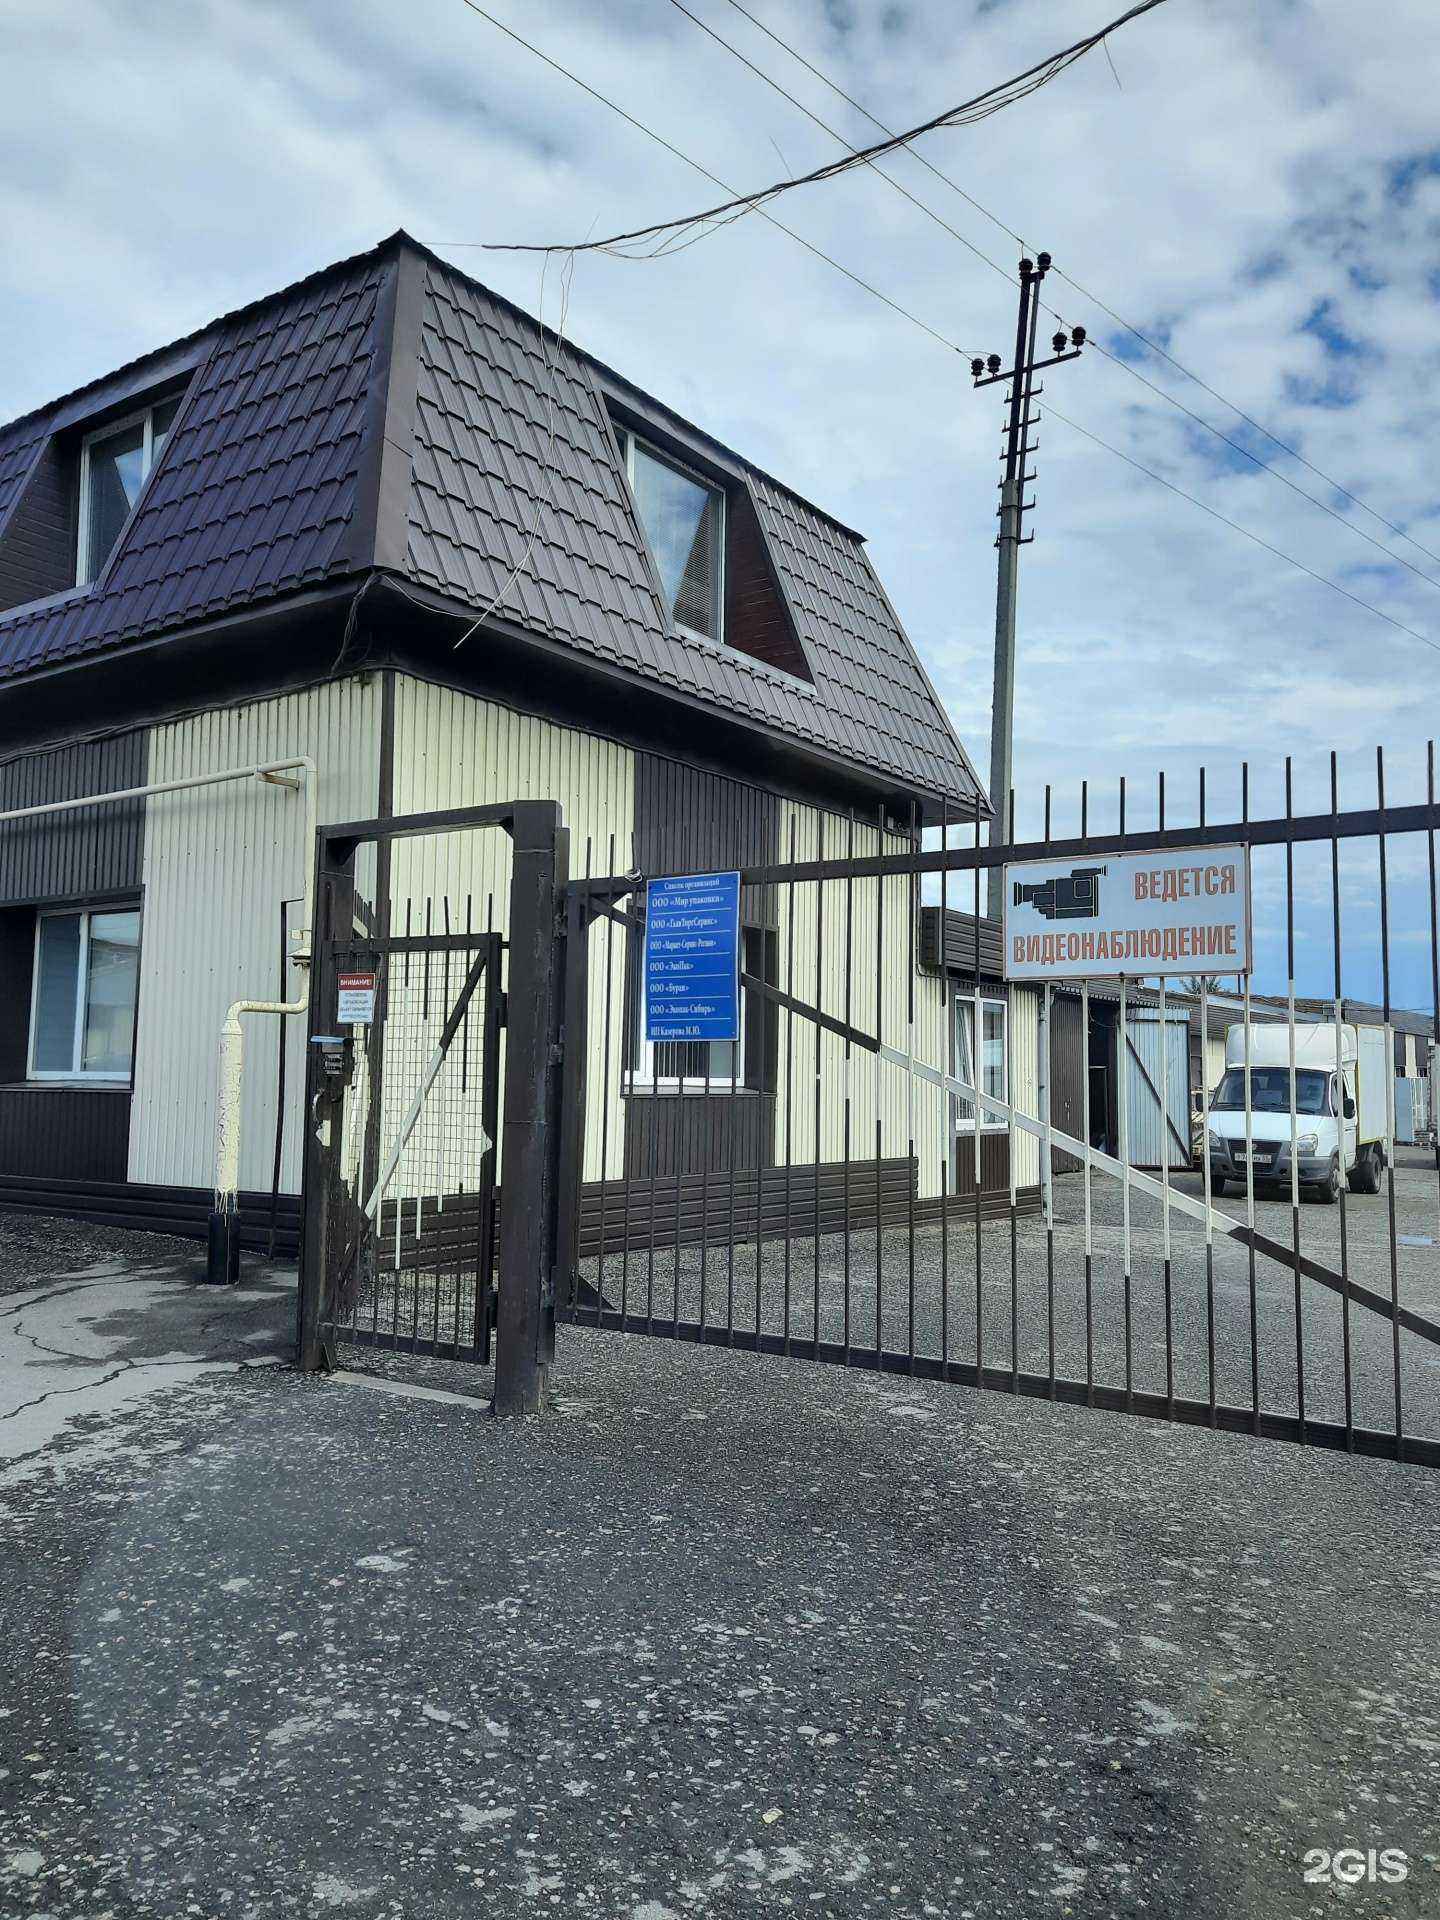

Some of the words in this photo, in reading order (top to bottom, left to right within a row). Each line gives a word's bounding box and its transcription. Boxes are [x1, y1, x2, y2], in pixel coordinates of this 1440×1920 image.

[1134, 864, 1236, 902] ВЕДЕТСЯ
[652, 897, 669, 907] ООО
[651, 919, 666, 929] ООО
[650, 939, 661, 951] ООО
[1013, 924, 1237, 965] ВИДЕОНАБЛЮДЕНИЕ
[650, 961, 664, 971] ООО
[650, 983, 664, 992] ООО
[650, 1004, 664, 1015] ООО
